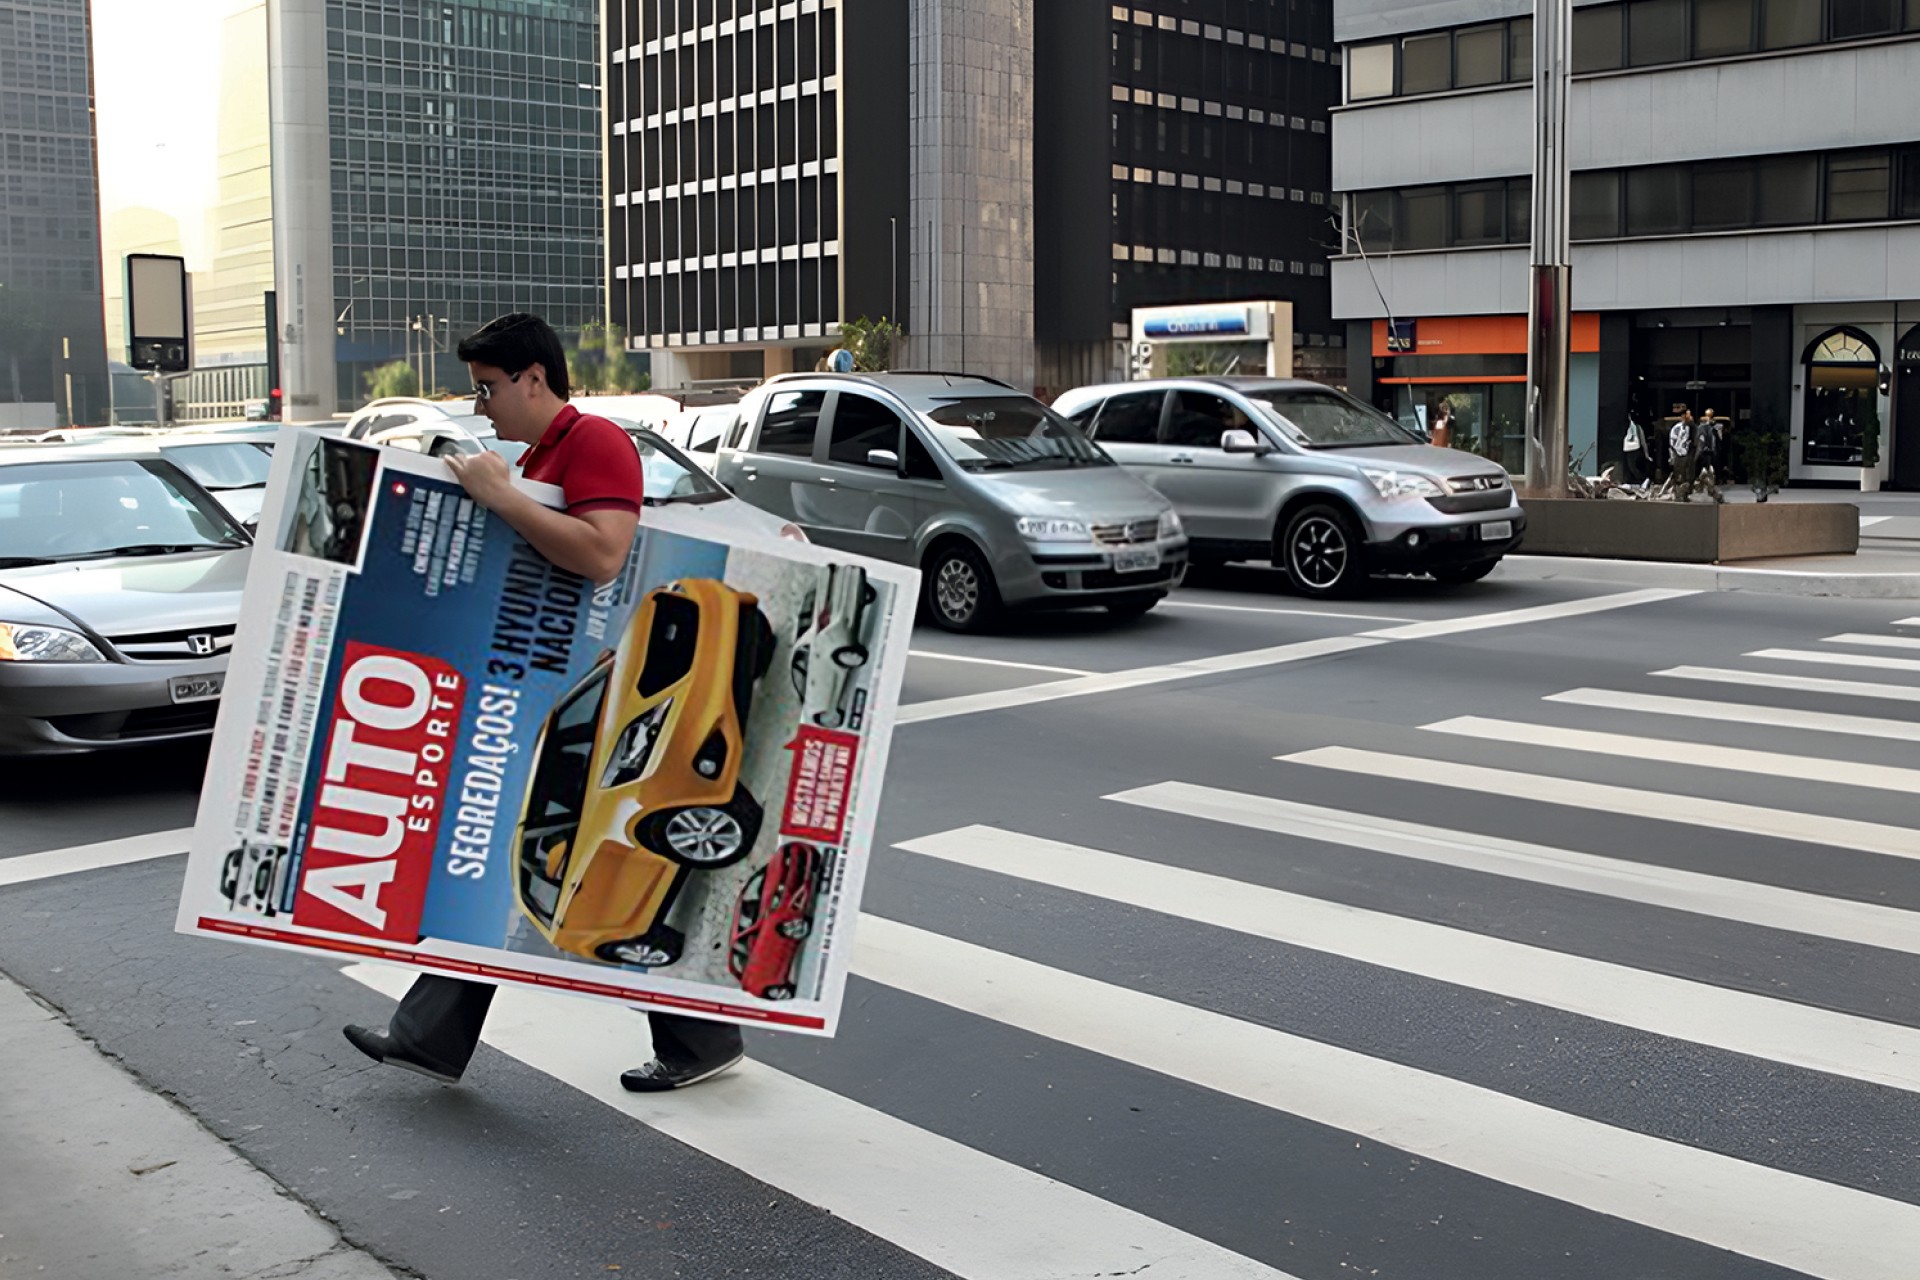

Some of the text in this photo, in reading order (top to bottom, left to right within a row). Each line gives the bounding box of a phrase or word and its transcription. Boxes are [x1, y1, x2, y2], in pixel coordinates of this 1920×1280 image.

[447, 542, 546, 878] SEGREDAÇOS! 3 HYUNDA
[529, 565, 586, 675] NACION
[303, 655, 431, 930] AUTO
[407, 673, 458, 831] ESPORTE
